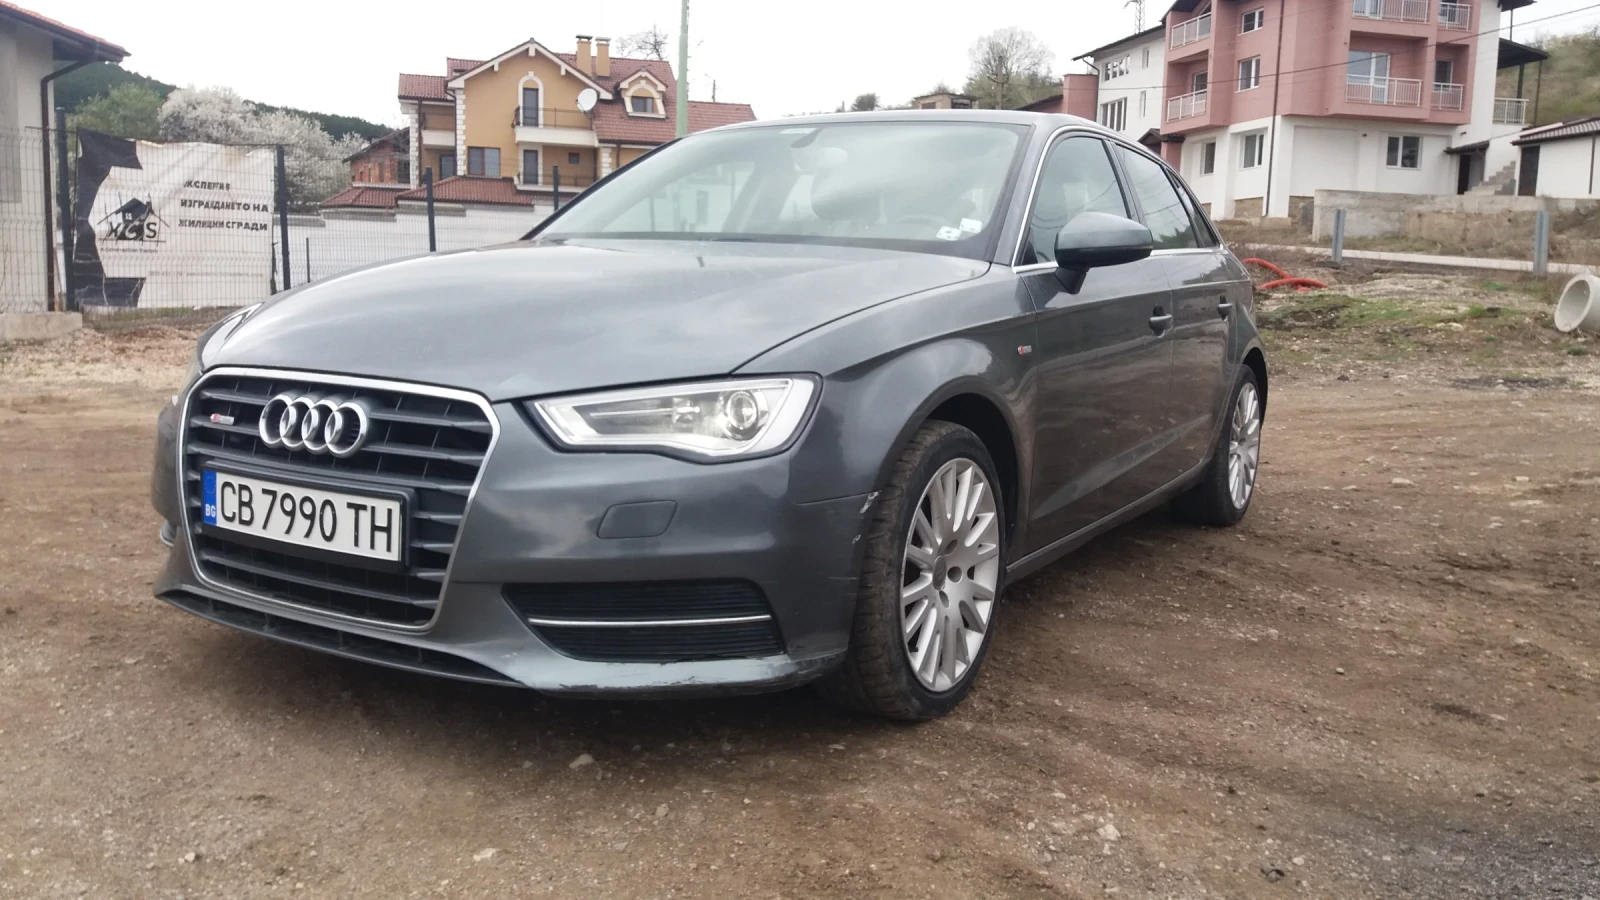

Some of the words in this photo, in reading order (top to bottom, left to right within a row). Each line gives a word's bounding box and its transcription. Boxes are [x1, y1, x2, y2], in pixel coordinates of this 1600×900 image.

[253, 203, 269, 212] НА
[225, 221, 268, 231] СГРАДИ
[205, 503, 216, 518] BG
[220, 481, 255, 526] CB
[261, 487, 338, 543] 7990
[346, 501, 393, 553] TH
